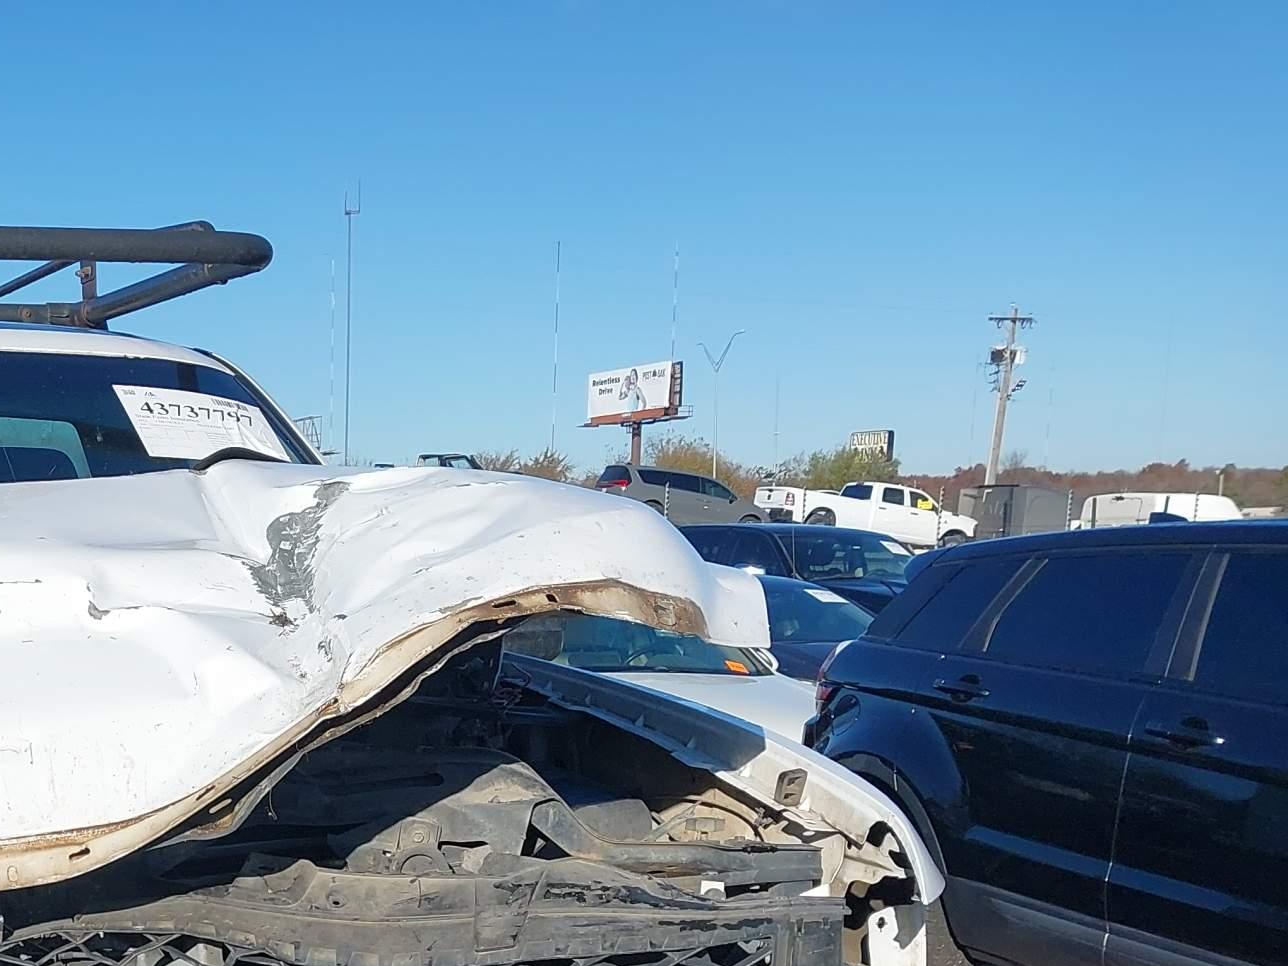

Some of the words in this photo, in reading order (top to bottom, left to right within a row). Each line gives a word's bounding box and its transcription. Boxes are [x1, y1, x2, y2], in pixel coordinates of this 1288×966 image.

[592, 376, 621, 387] Relentless
[598, 387, 613, 396] Drive
[140, 401, 252, 427] 43737797
[851, 432, 888, 446] EXECUTIVE
